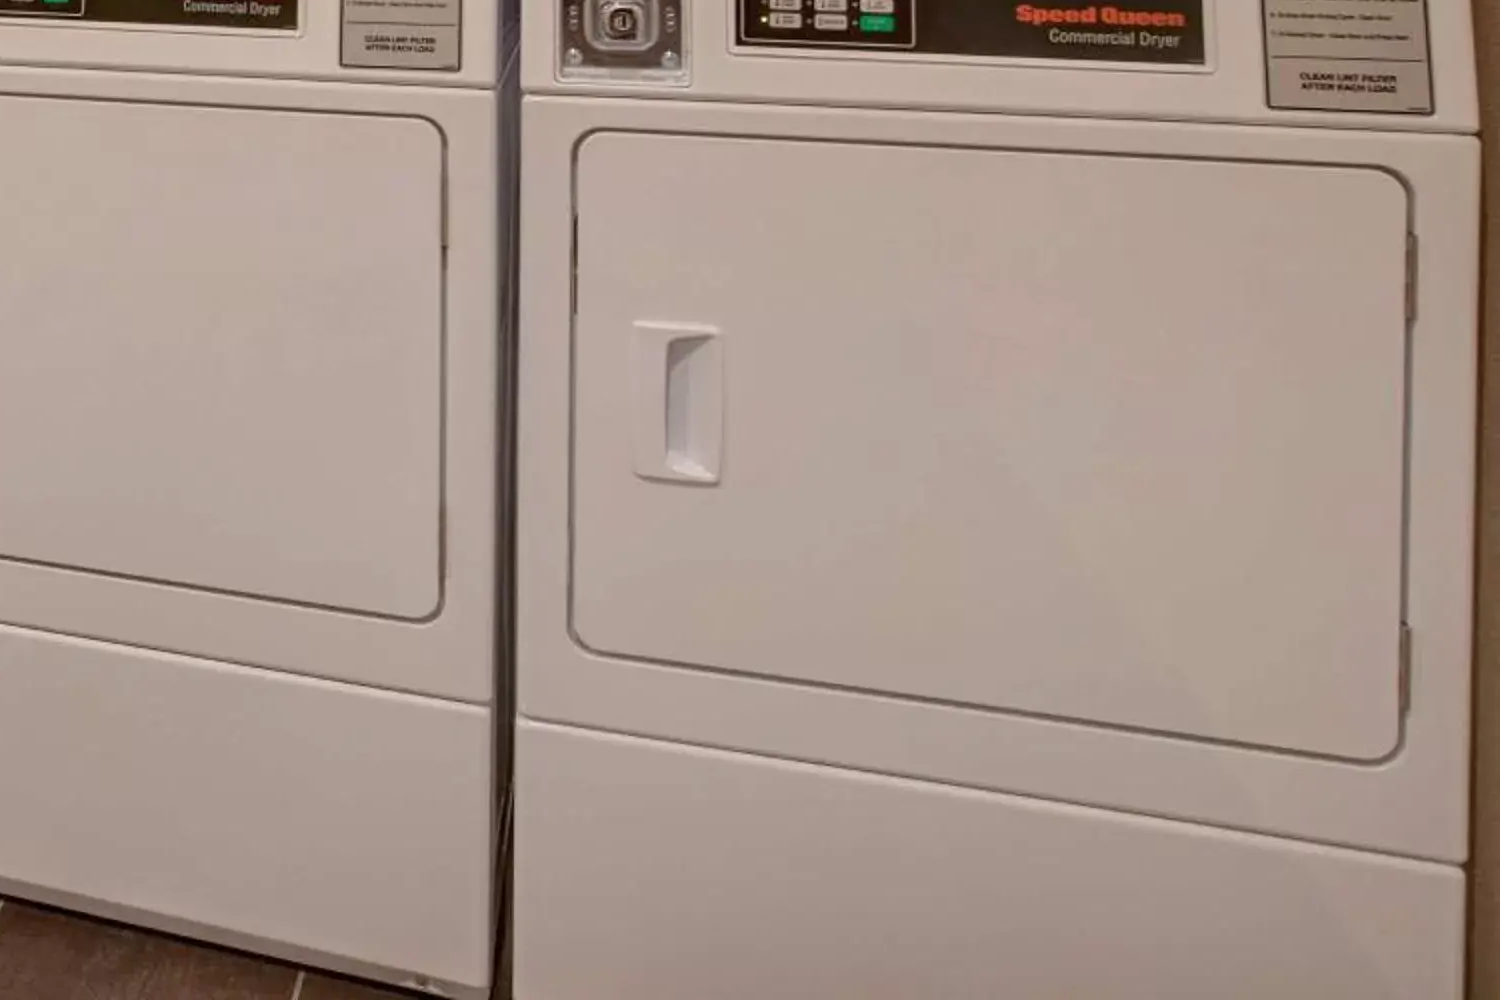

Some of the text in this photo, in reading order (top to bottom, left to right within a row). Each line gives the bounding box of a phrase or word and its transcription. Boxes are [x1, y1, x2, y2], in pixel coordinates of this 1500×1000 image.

[183, 0, 281, 17] Commercial Dryer
[1016, 4, 1186, 27] Speed Queen
[1049, 27, 1181, 48] Commercial Dryer
[1300, 72, 1397, 83] CLEAN LINT FILTER
[1301, 82, 1335, 91] AFTER
